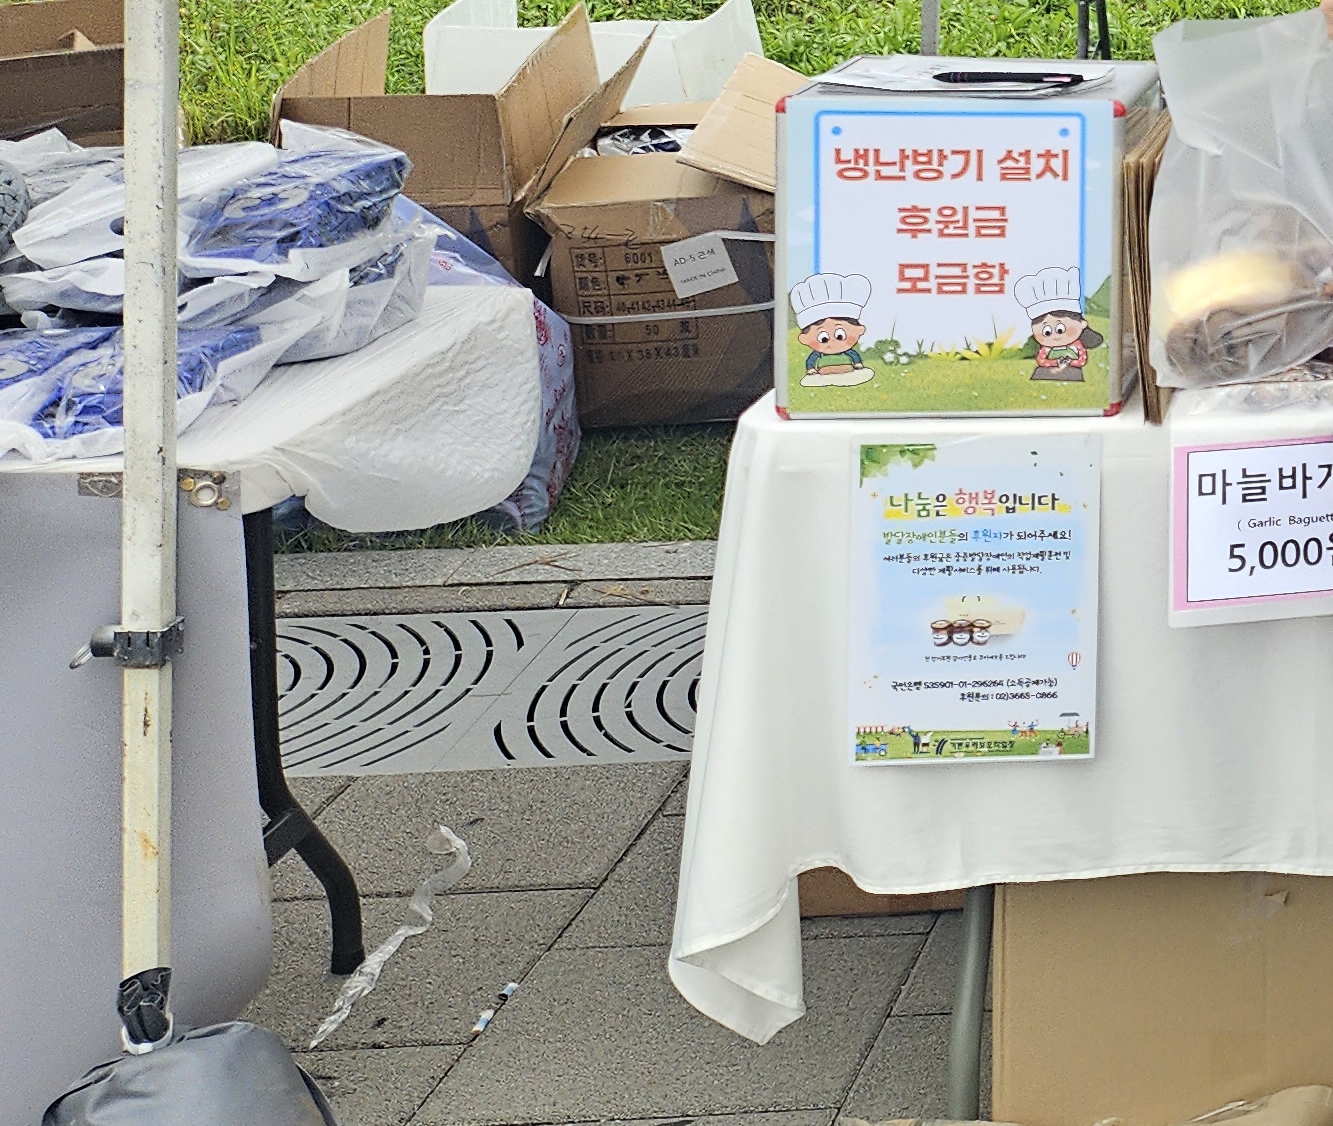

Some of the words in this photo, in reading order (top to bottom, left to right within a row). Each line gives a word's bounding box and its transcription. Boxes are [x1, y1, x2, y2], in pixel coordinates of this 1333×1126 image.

[834, 147, 984, 182] 냉난방기
[997, 147, 1069, 182] 설치
[896, 204, 1009, 239] 후원금
[896, 261, 1009, 295] 모금함
[889, 491, 947, 518] 나눔은
[955, 488, 1060, 516] 행복입니다
[883, 528, 969, 545] 발달장애인분들의
[971, 528, 1013, 542] 후원자가
[1016, 529, 1072, 541] 되어주세요!
[1248, 515, 1281, 529] Garlic
